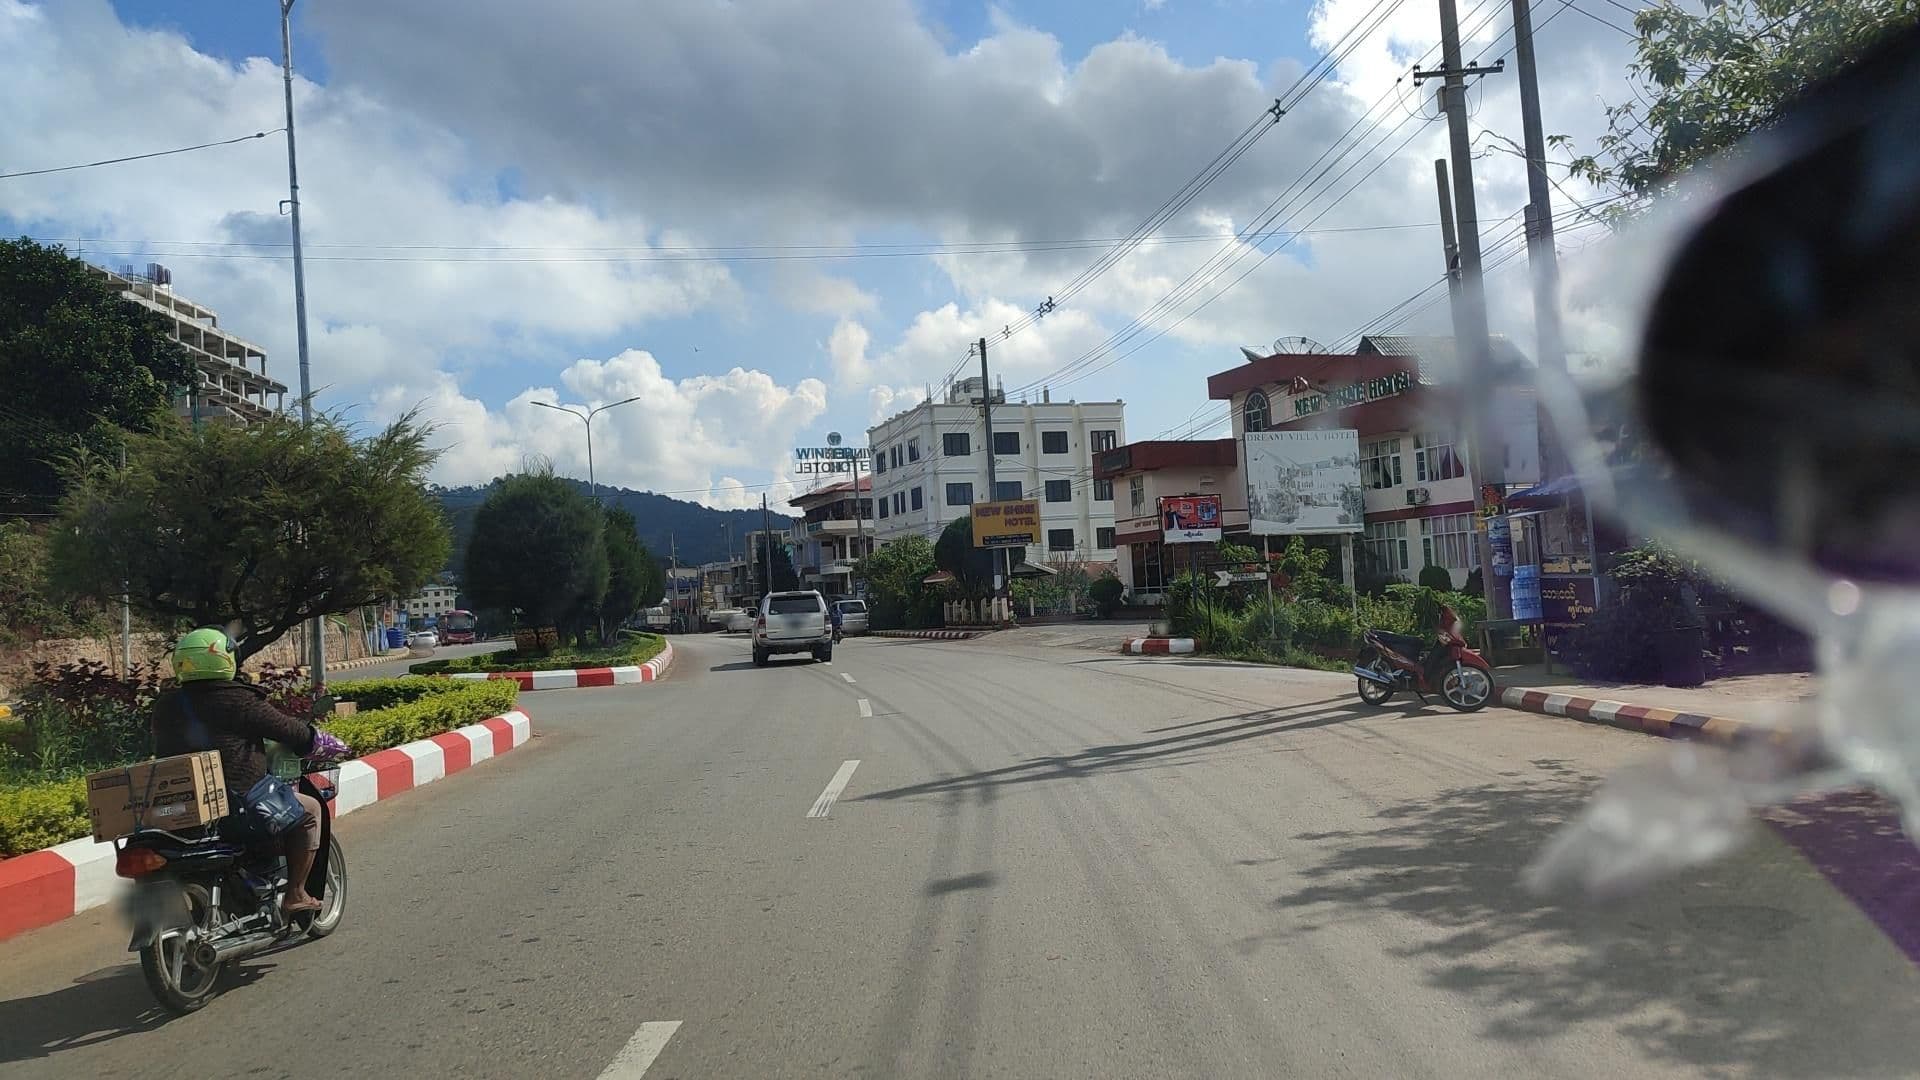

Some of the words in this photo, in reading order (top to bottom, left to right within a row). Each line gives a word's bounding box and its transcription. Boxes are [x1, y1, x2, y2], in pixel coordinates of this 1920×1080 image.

[1295, 396, 1320, 416] NEW
[1369, 370, 1411, 399] HOTEL
[1247, 432, 1283, 441] DREAM
[1288, 432, 1318, 441] VILLA
[1324, 430, 1356, 441] HOTEL
[976, 507, 1000, 517] NEW
[1004, 517, 1037, 527] HOTEL
